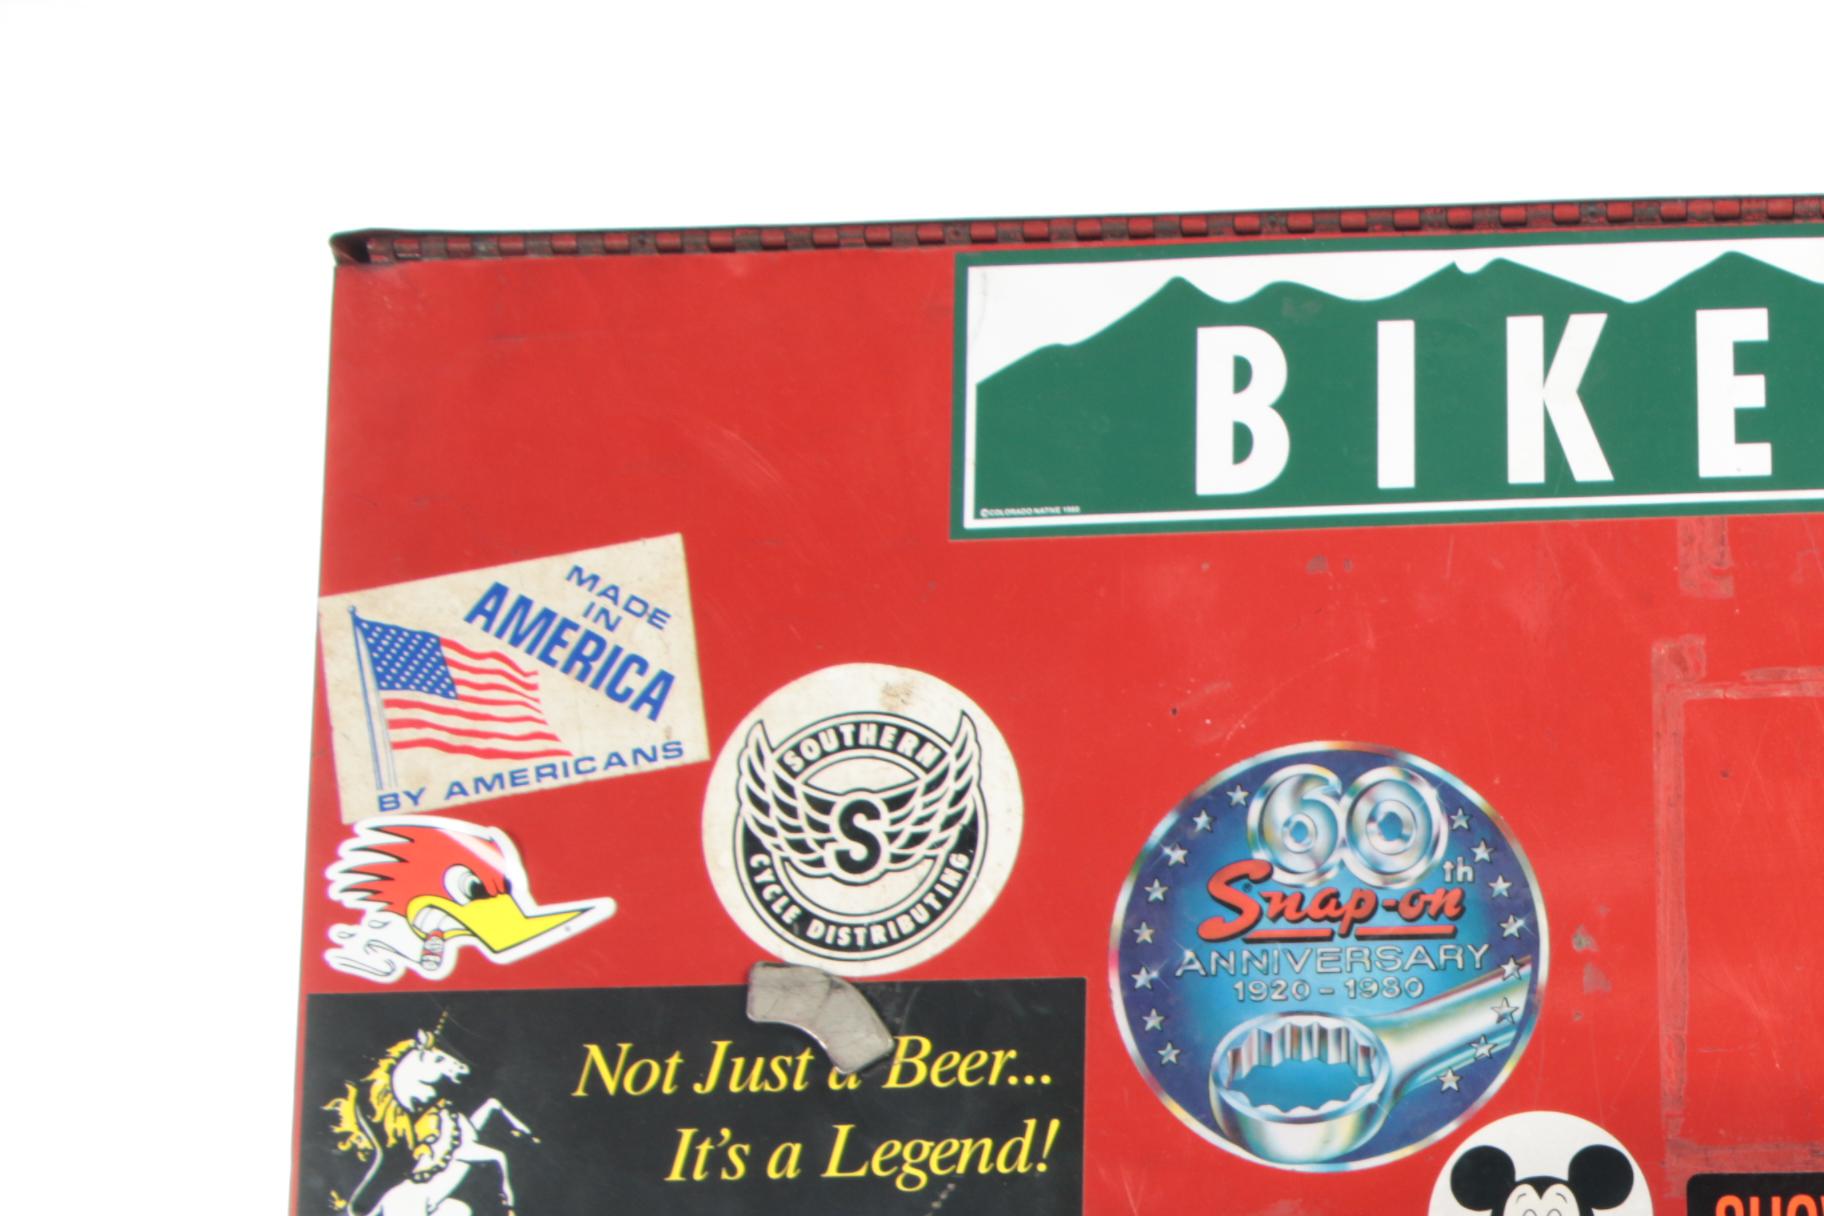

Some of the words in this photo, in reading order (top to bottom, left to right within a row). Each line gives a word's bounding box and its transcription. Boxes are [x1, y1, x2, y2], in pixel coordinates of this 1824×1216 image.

[564, 565, 672, 631] MADE
[582, 601, 623, 633] IN
[463, 581, 676, 722] AMERICA
[377, 787, 426, 813] BY
[445, 740, 684, 801] AMERICANS
[782, 722, 942, 773] SOUTHERN
[834, 799, 882, 875] S
[749, 852, 802, 924] CYCLE
[806, 852, 970, 947] DISTRIBUTING
[1196, 859, 1465, 941] Snap-on
[1175, 943, 1490, 977] ANNIVERSARY
[1232, 978, 1311, 1002] 1920
[571, 1042, 683, 1097] Not
[693, 1039, 814, 1095] Just
[882, 1034, 1053, 1089] Beer...
[664, 1127, 751, 1182] It's
[766, 1142, 802, 1180] a
[821, 1118, 1061, 1192] Legend!
